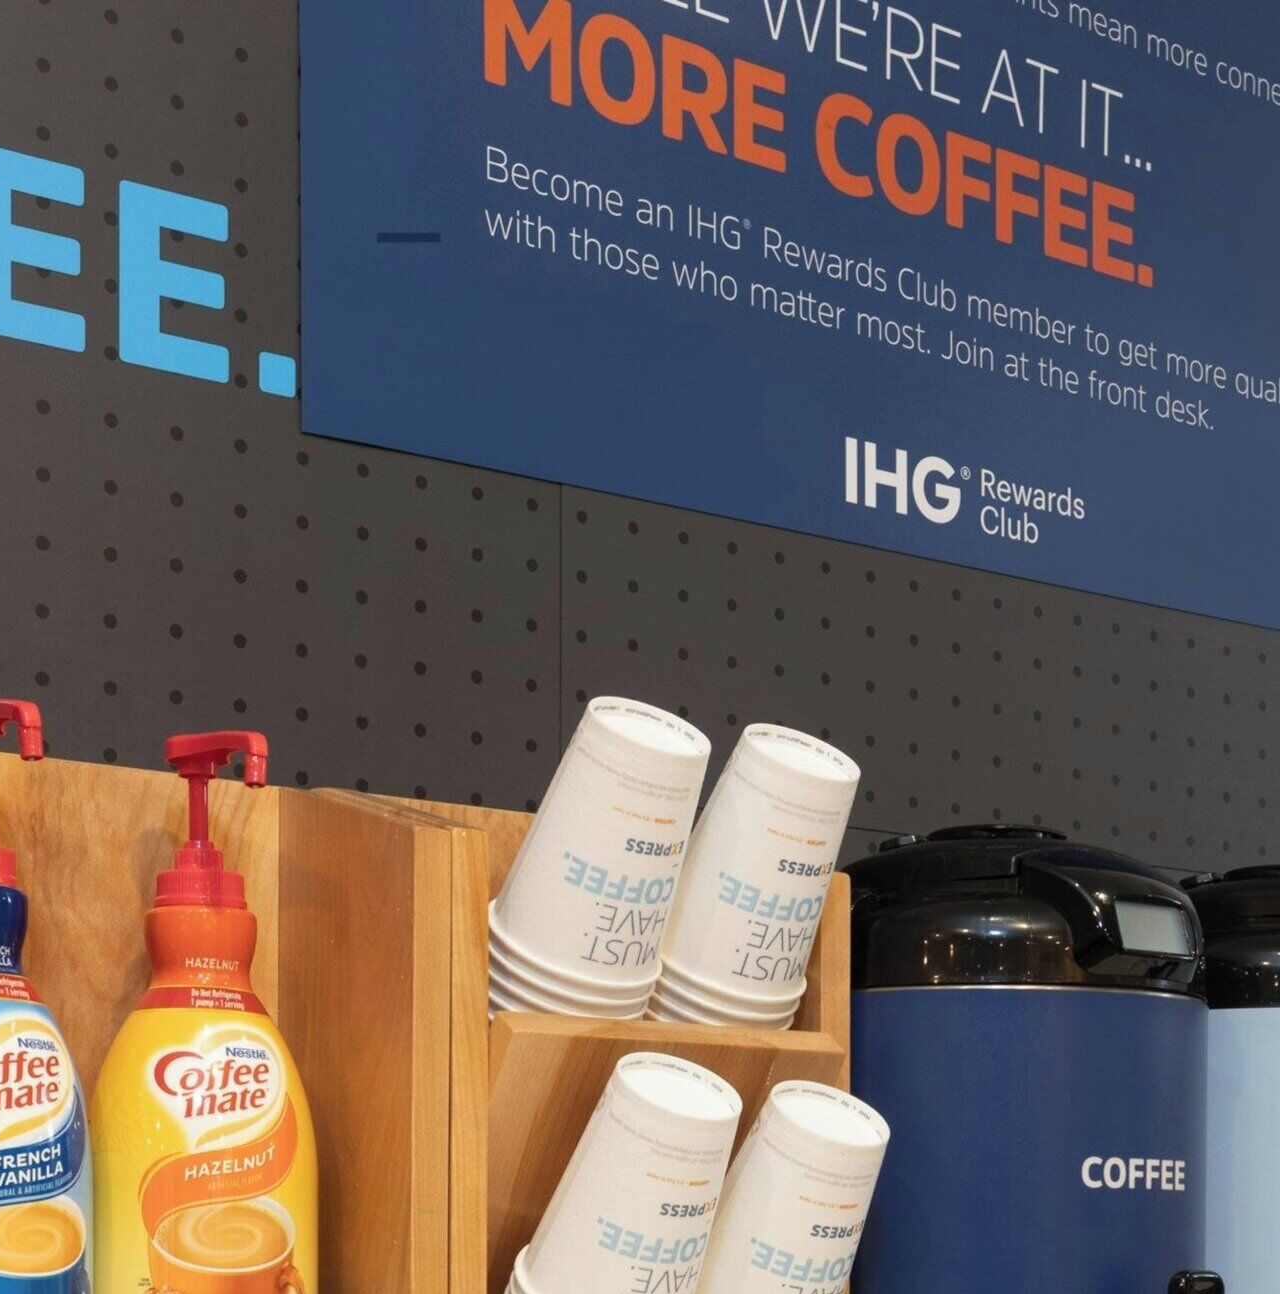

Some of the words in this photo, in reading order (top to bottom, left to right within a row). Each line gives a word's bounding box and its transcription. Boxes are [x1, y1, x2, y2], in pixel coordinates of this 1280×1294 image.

[1069, 2, 1138, 49] mean
[1148, 30, 1207, 76] more
[981, 49, 1059, 134] AT
[483, 0, 786, 173] MORE
[815, 93, 1153, 288] COFFEE.
[486, 146, 623, 216] Become
[636, 198, 674, 231] an
[764, 226, 887, 292] Rewards
[898, 267, 956, 312] Club
[967, 294, 1075, 345] member
[1084, 323, 1109, 356] to
[1118, 339, 1158, 370] get
[1167, 350, 1227, 389] more
[485, 209, 556, 253] with
[568, 226, 659, 281] those
[672, 260, 738, 301] who
[751, 281, 845, 330] matter
[857, 311, 931, 355] most.
[941, 330, 994, 371] Join
[1005, 351, 1030, 382] at
[1038, 357, 1079, 394] the
[1088, 370, 1147, 414] front
[1156, 390, 1215, 431] desk.
[981, 469, 1085, 520] Rewards
[980, 505, 1039, 544] Club
[625, 838, 684, 856] EXPRESS
[564, 851, 675, 903] COFFEE.
[777, 858, 834, 877] EXPRESS
[717, 870, 823, 921] COFFEE.
[595, 902, 665, 935] HAVE.
[746, 919, 813, 950] HAVE.
[185, 957, 240, 971] HAZELNUT
[580, 932, 657, 967] MUST.
[732, 948, 806, 982] MUST.
[154, 1051, 270, 1096] Coffee
[184, 1088, 267, 1118] mate
[184, 1143, 276, 1182] HAZELNUT
[1081, 1156, 1186, 1191] COFFEE
[24, 1181, 54, 1194] ARTIFICIAL
[596, 1215, 708, 1265] COFFEE.
[629, 1266, 699, 1294] HAVE.
[750, 1236, 853, 1285] COFFEE.
